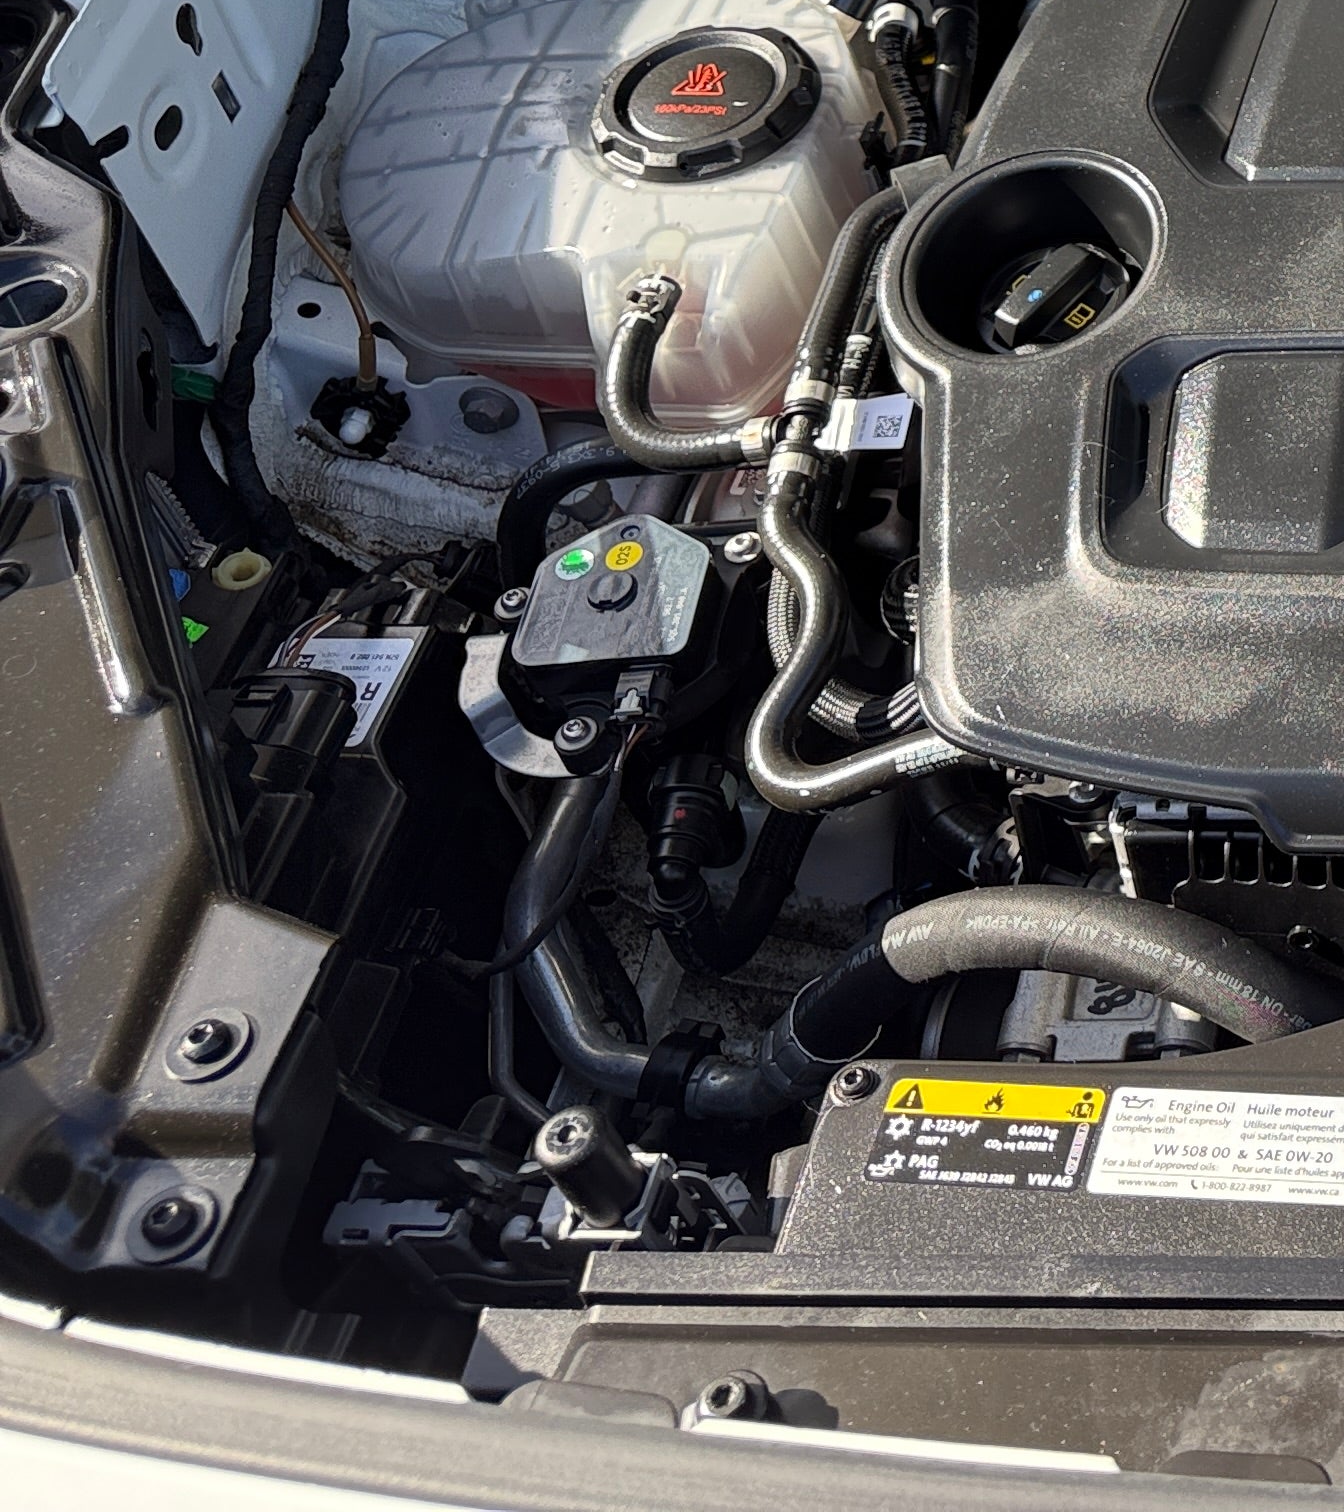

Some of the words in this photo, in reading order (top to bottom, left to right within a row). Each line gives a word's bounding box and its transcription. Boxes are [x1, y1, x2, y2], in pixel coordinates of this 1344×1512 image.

[360, 682, 382, 701] R
[1168, 1100, 1213, 1114] Engine
[1216, 1102, 1235, 1113] Oil
[1247, 1104, 1282, 1116] Huile
[1285, 1106, 1335, 1118] moteur
[921, 1118, 980, 1136] R-1234yf
[1115, 1113, 1132, 1122] Use
[1134, 1115, 1154, 1124] only
[1155, 1114, 1166, 1123] oil
[1169, 1115, 1187, 1124] that
[1189, 1117, 1231, 1127] expressly
[1243, 1120, 1277, 1130] Utilisez
[1280, 1121, 1335, 1134] uniquement
[1112, 1125, 1152, 1135] complies
[1154, 1126, 1175, 1134] with
[1240, 1132, 1255, 1141] qui
[1258, 1132, 1294, 1142] satisfait
[1154, 1144, 1178, 1155] VW
[1182, 1145, 1208, 1157] 508
[1212, 1147, 1231, 1158] 00
[1238, 1150, 1248, 1159] &
[1256, 1149, 1283, 1161] SAE
[1286, 1151, 1333, 1164] 0W-20
[908, 1154, 939, 1169] PAG
[1103, 1158, 1118, 1166] For
[1127, 1159, 1140, 1168] list
[1143, 1159, 1154, 1168] of
[1155, 1160, 1198, 1171] approved
[1232, 1164, 1253, 1173] Pour
[1255, 1166, 1273, 1174] une
[1275, 1165, 1291, 1175] liste
[1295, 1165, 1329, 1177] d'huiles
[1028, 1173, 1051, 1186] VW
[1052, 1174, 1073, 1187] AG
[1118, 1178, 1178, 1187] www.vw.com
[1201, 1181, 1272, 1193] 1-800-822-8987
[1288, 1186, 1340, 1196] www.vw.ca
